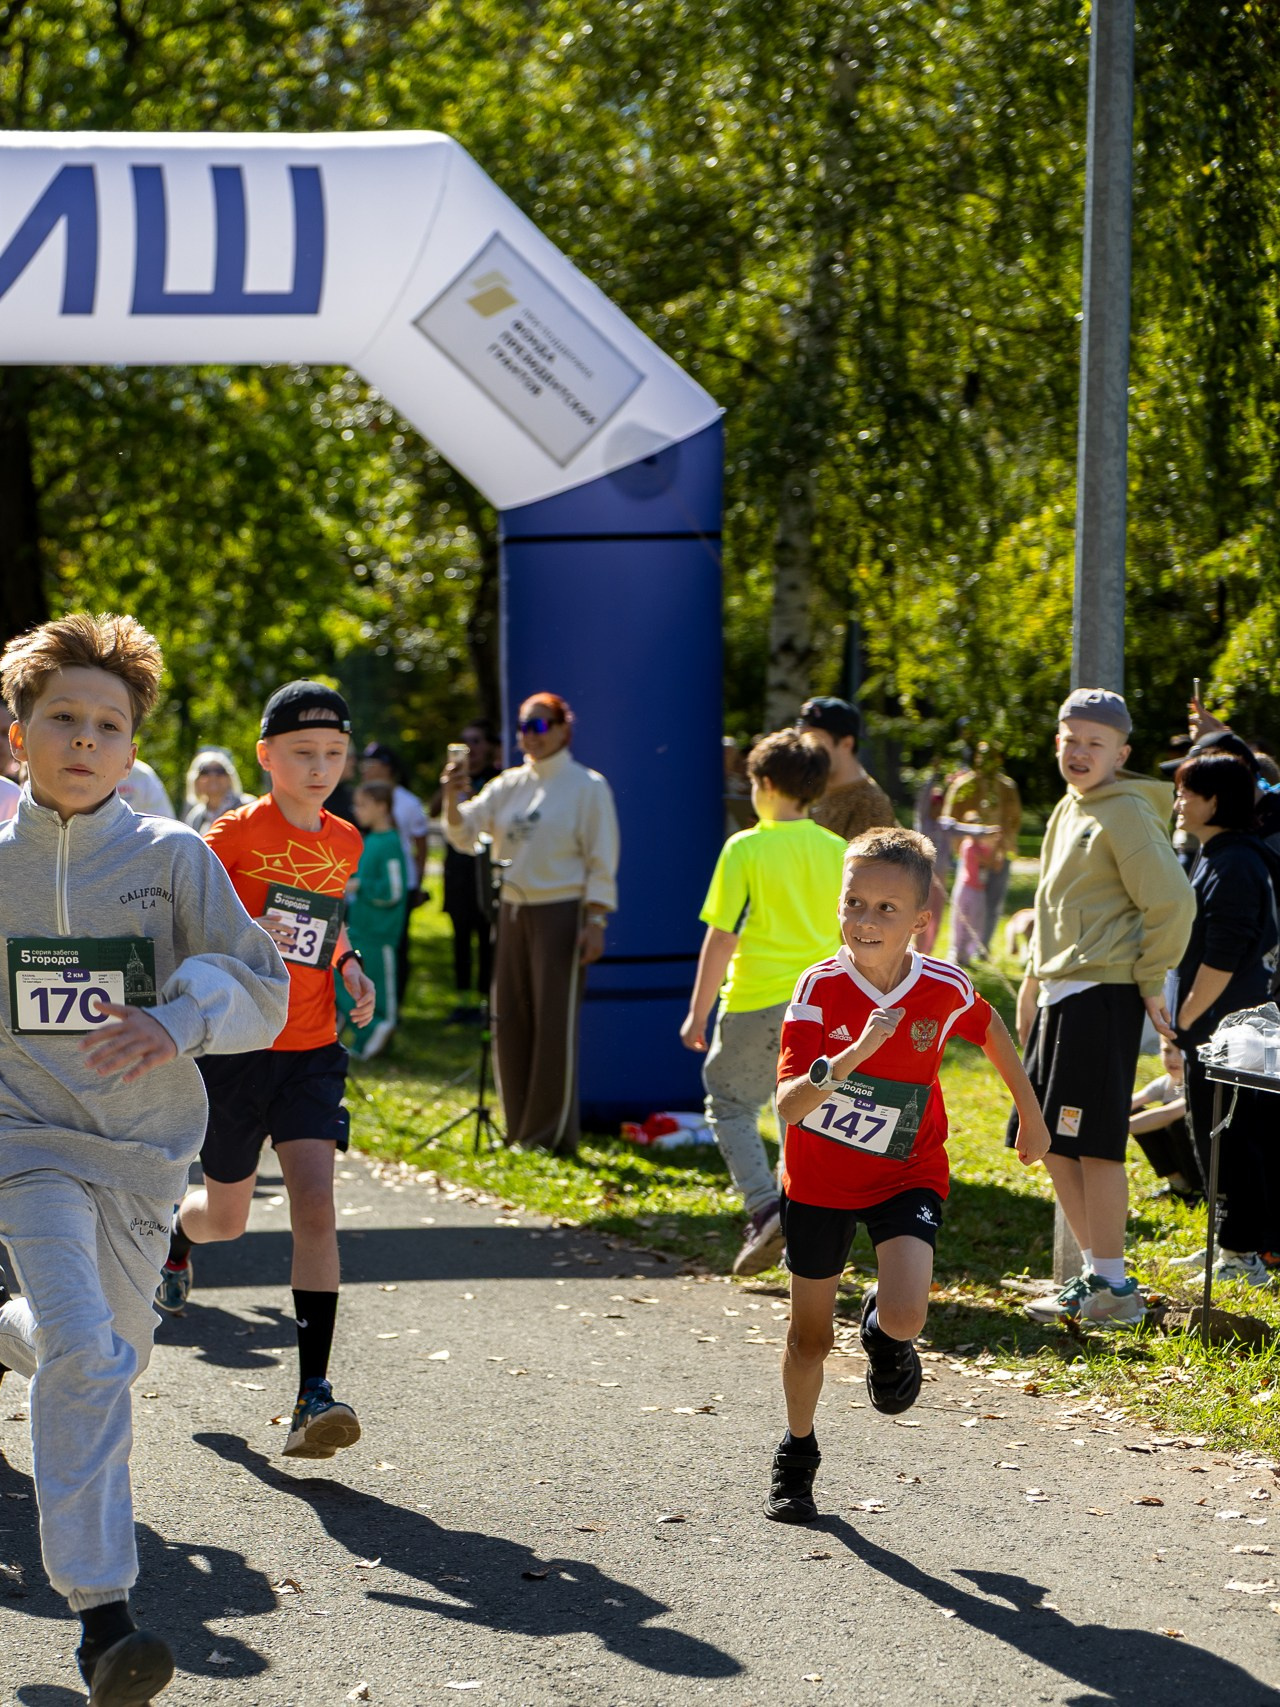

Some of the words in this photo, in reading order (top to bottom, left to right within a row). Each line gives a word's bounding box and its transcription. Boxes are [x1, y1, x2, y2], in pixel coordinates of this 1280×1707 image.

[120, 887, 173, 904] CALIFORNI
[274, 892, 283, 903] 5
[275, 926, 317, 957] 43
[21, 950, 31, 963] 5
[32, 956, 79, 965] городов
[30, 987, 111, 1023] 170
[828, 1033, 852, 1041] adidas
[840, 1083, 872, 1096] ородов
[854, 1080, 875, 1091] забегов
[821, 1103, 887, 1143] 147
